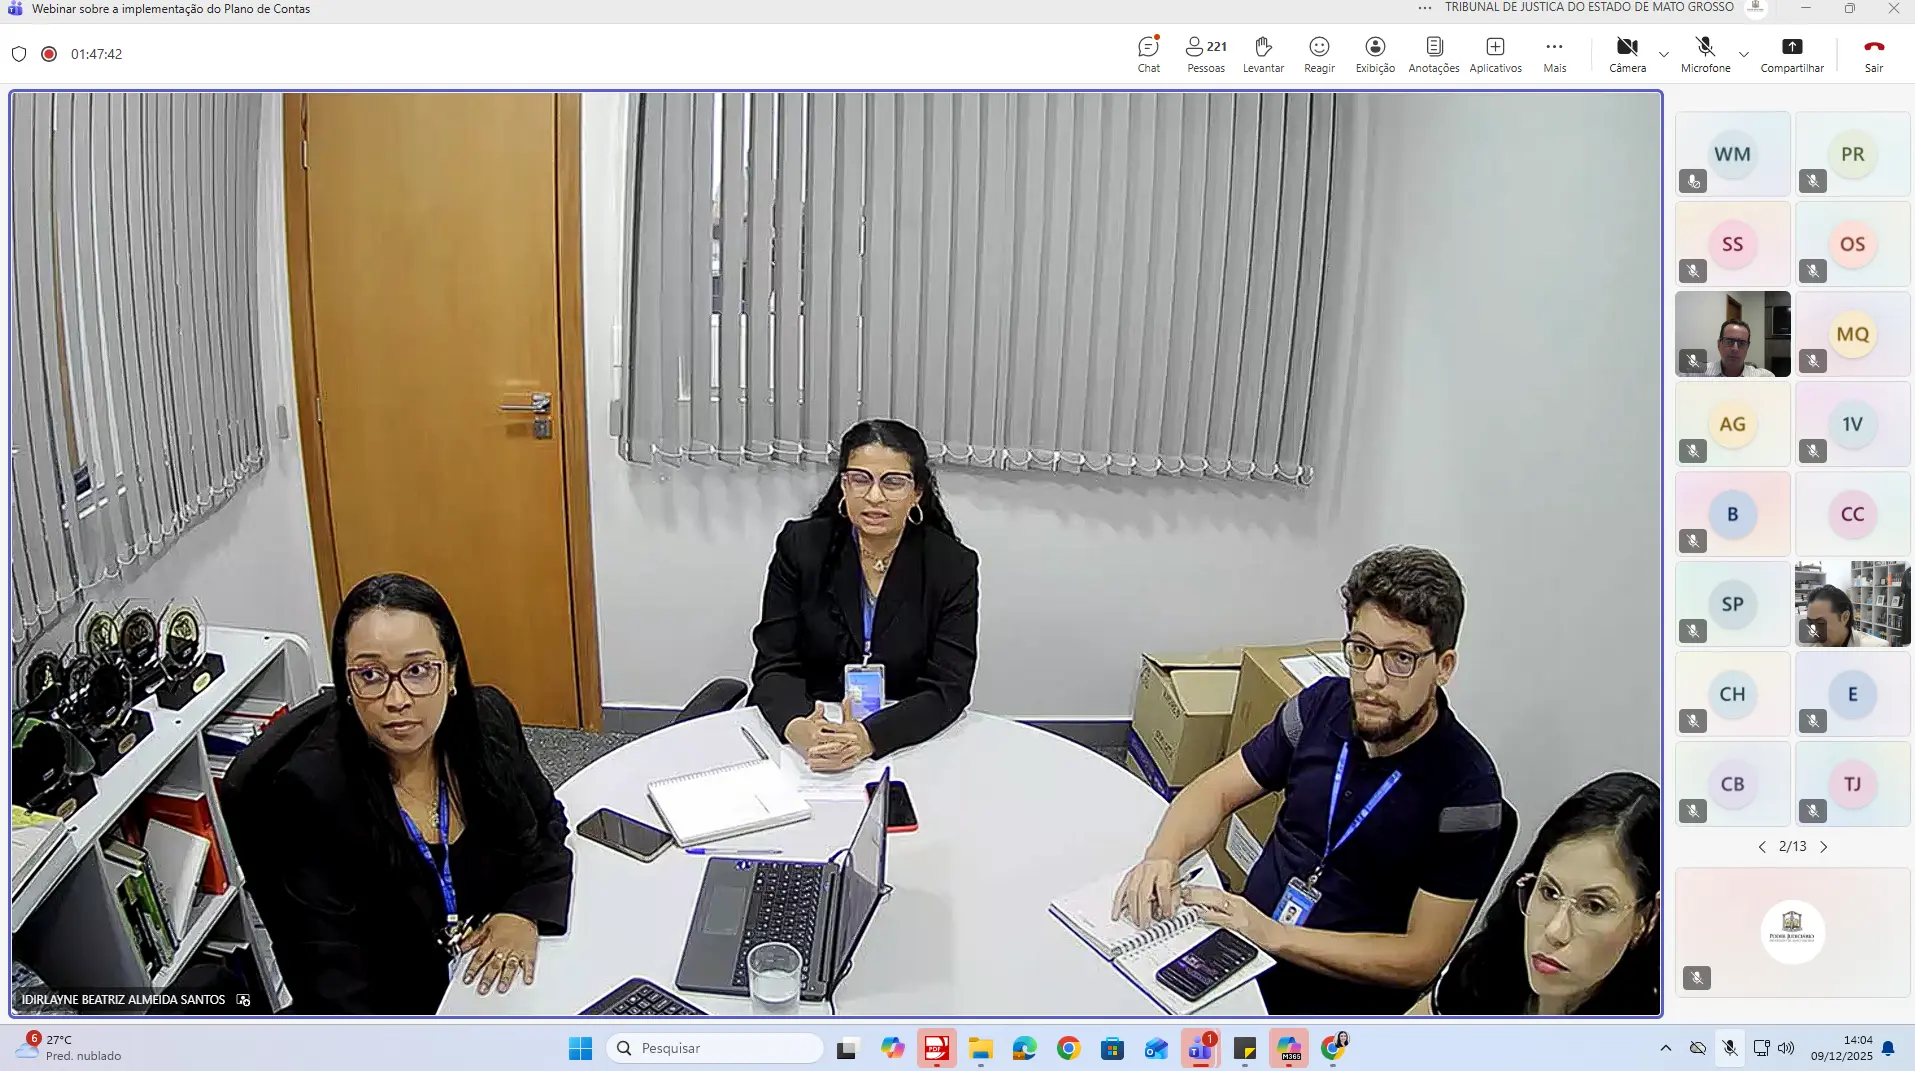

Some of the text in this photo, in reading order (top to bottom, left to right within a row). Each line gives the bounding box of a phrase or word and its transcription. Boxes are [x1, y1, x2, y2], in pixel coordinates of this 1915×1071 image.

[31, 3, 311, 17] Webinar sobre a implementação do Plano de Contas
[1444, 1, 1735, 12] TRIBUNAL DE JUSTICA DO ESTADO DE MATO GROSSO
[1206, 41, 1227, 52] 221
[71, 48, 123, 60] 01:47:42
[1137, 63, 1161, 73] Chat
[1187, 63, 1226, 73] Pessoas
[1243, 63, 1285, 73] Levantar
[1304, 63, 1336, 75] Reagir
[1356, 62, 1396, 76] Exibição
[1408, 62, 1460, 76] Anotações
[1469, 63, 1523, 75] Aplicativos
[1543, 63, 1567, 73] Mais
[1609, 62, 1647, 73] Câmera
[1681, 63, 1731, 73] Microfone
[1760, 63, 1825, 75] Compartilhar
[1865, 63, 1884, 73] Sair
[1714, 146, 1751, 162] WM
[1842, 146, 1866, 162] PR
[1722, 236, 1744, 252] SS
[1840, 236, 1866, 252] OS
[1837, 326, 1870, 344] MQ
[1719, 416, 1746, 432] AG
[1842, 416, 1864, 432] 1V
[1727, 506, 1739, 522] B
[1841, 506, 1865, 522] CC
[1722, 596, 1744, 612] SP
[1719, 686, 1745, 702] CH
[1848, 686, 1858, 702] E
[1720, 776, 1745, 792] CB
[1843, 776, 1861, 792] TJ
[1779, 840, 1807, 854] 2/13
[21, 993, 226, 1006] IDIRLAYNE BEATRIZ ALMEIDA SANTOS
[31, 1033, 38, 1043] 6
[46, 1035, 72, 1045] 27°C
[1207, 1033, 1212, 1044] 1
[1844, 1035, 1874, 1045] 14:04
[46, 1050, 122, 1061] Pred. nublado
[642, 1041, 701, 1057] Pesquisar
[1810, 1051, 1874, 1063] 09/12/2025
